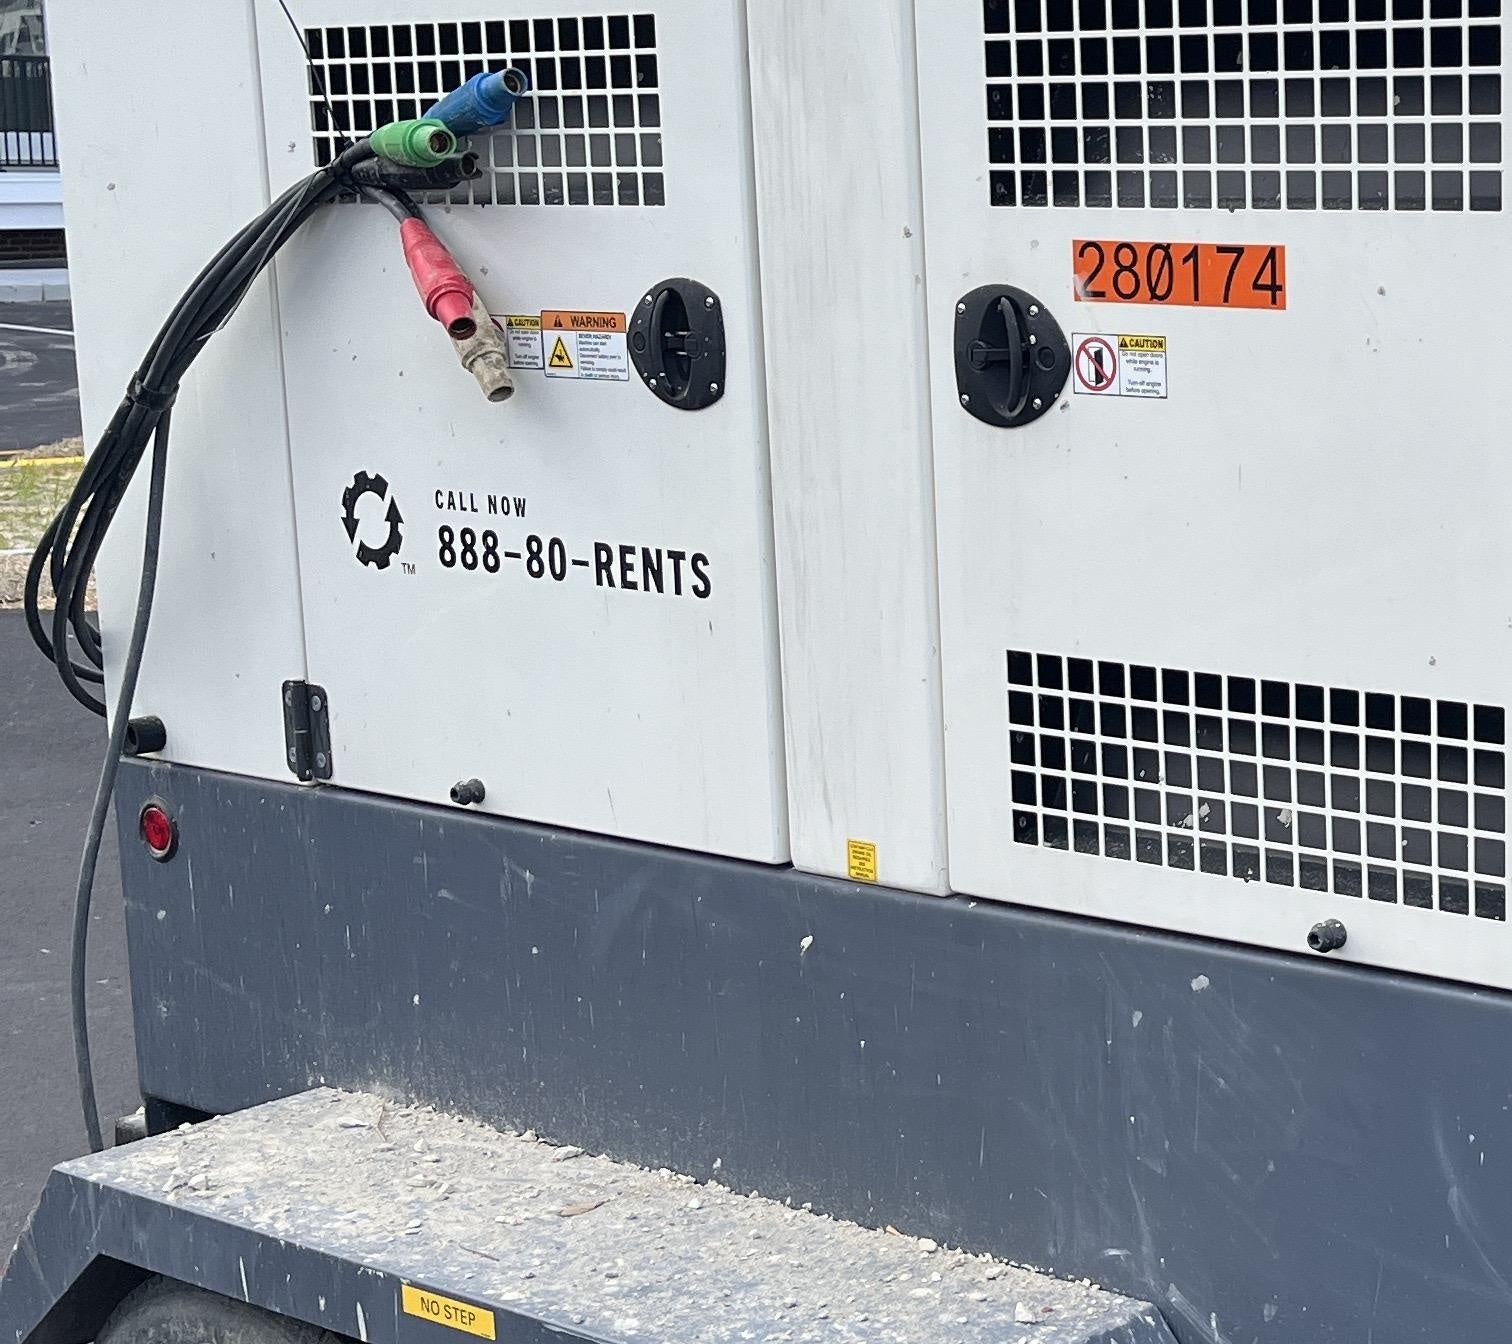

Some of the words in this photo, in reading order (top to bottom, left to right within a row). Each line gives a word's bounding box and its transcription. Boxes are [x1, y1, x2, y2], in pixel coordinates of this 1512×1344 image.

[1078, 241, 1284, 305] 280174
[514, 318, 540, 328] CAUTION
[570, 315, 617, 329] WARNING
[1128, 337, 1164, 349] CAUTION
[435, 489, 479, 514] CALL
[487, 493, 528, 519] NOW
[437, 524, 712, 600] 888-80-RENTS
[420, 1296, 440, 1316] NO
[443, 1304, 476, 1326] STEP
